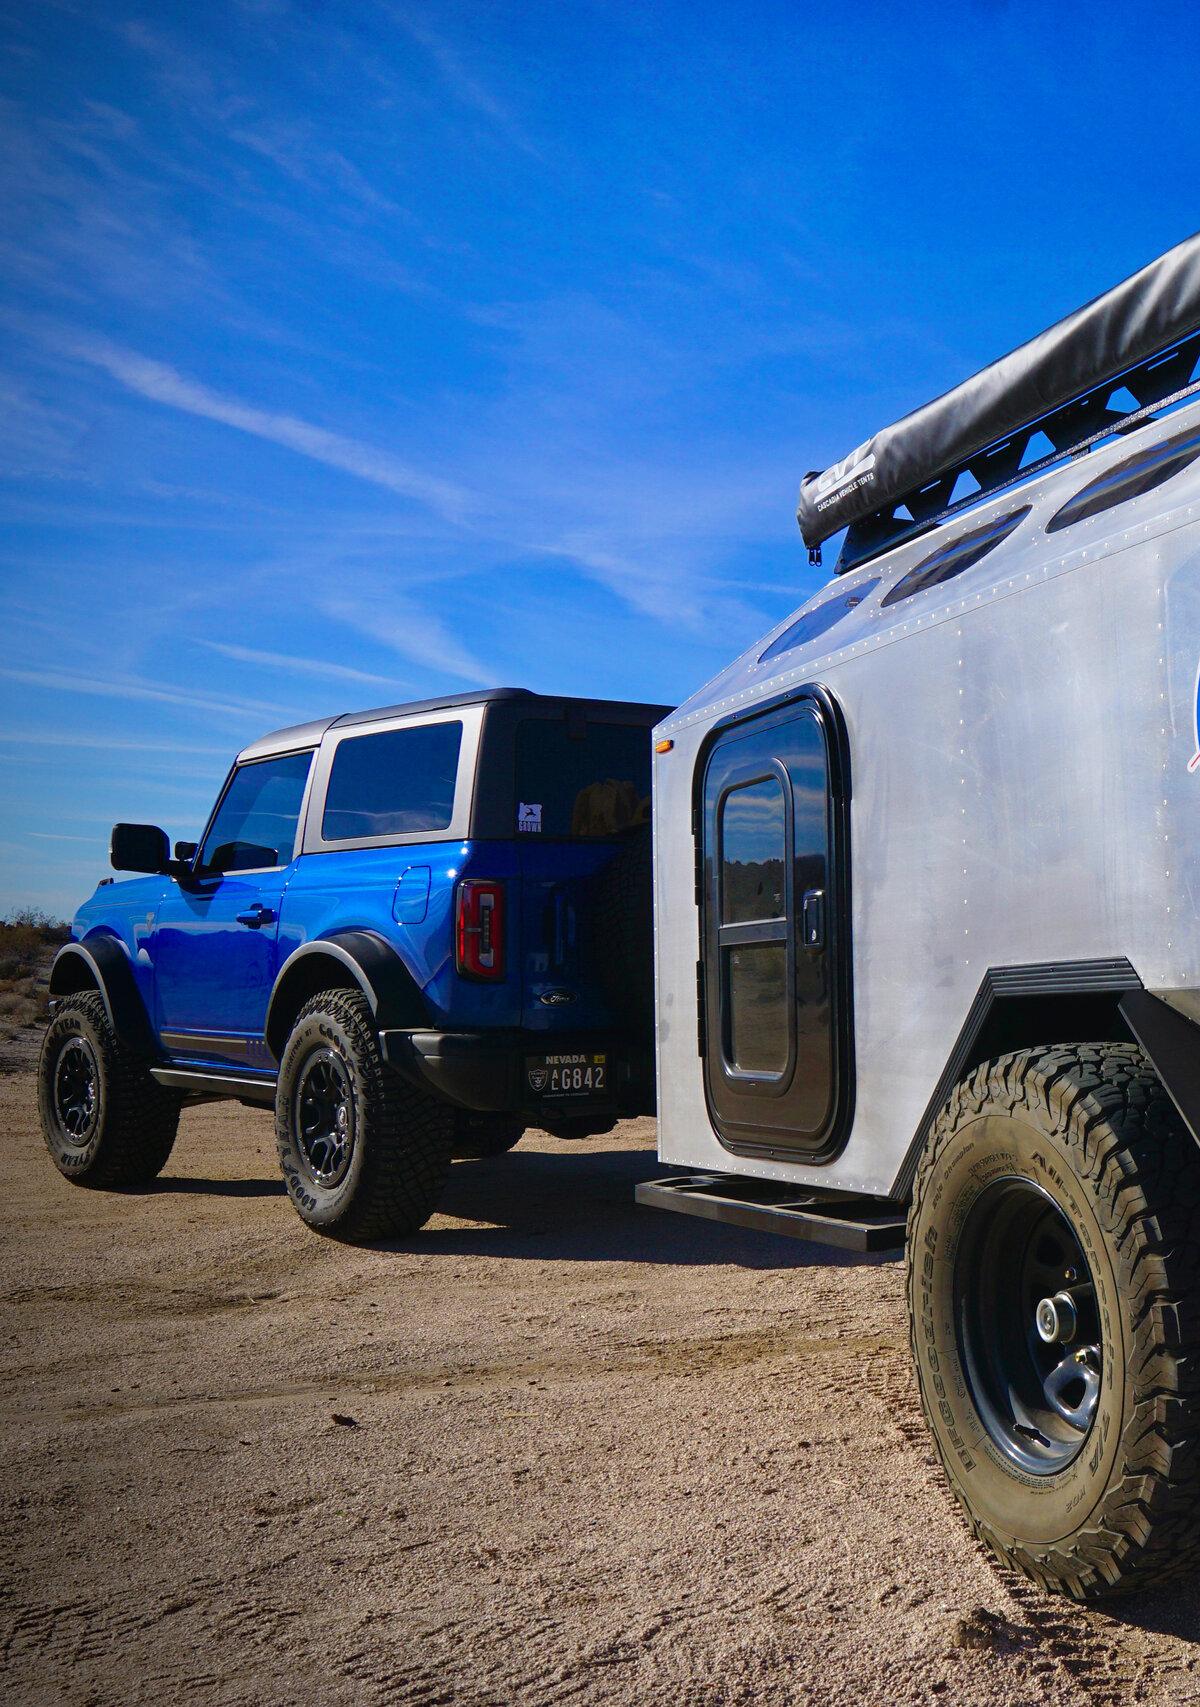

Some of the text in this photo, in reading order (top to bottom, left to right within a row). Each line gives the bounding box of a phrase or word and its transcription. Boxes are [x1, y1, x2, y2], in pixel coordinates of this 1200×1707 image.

[839, 481, 859, 498] VEHICLE
[858, 472, 875, 486] TENTS
[545, 1054, 587, 1065] NEVADA
